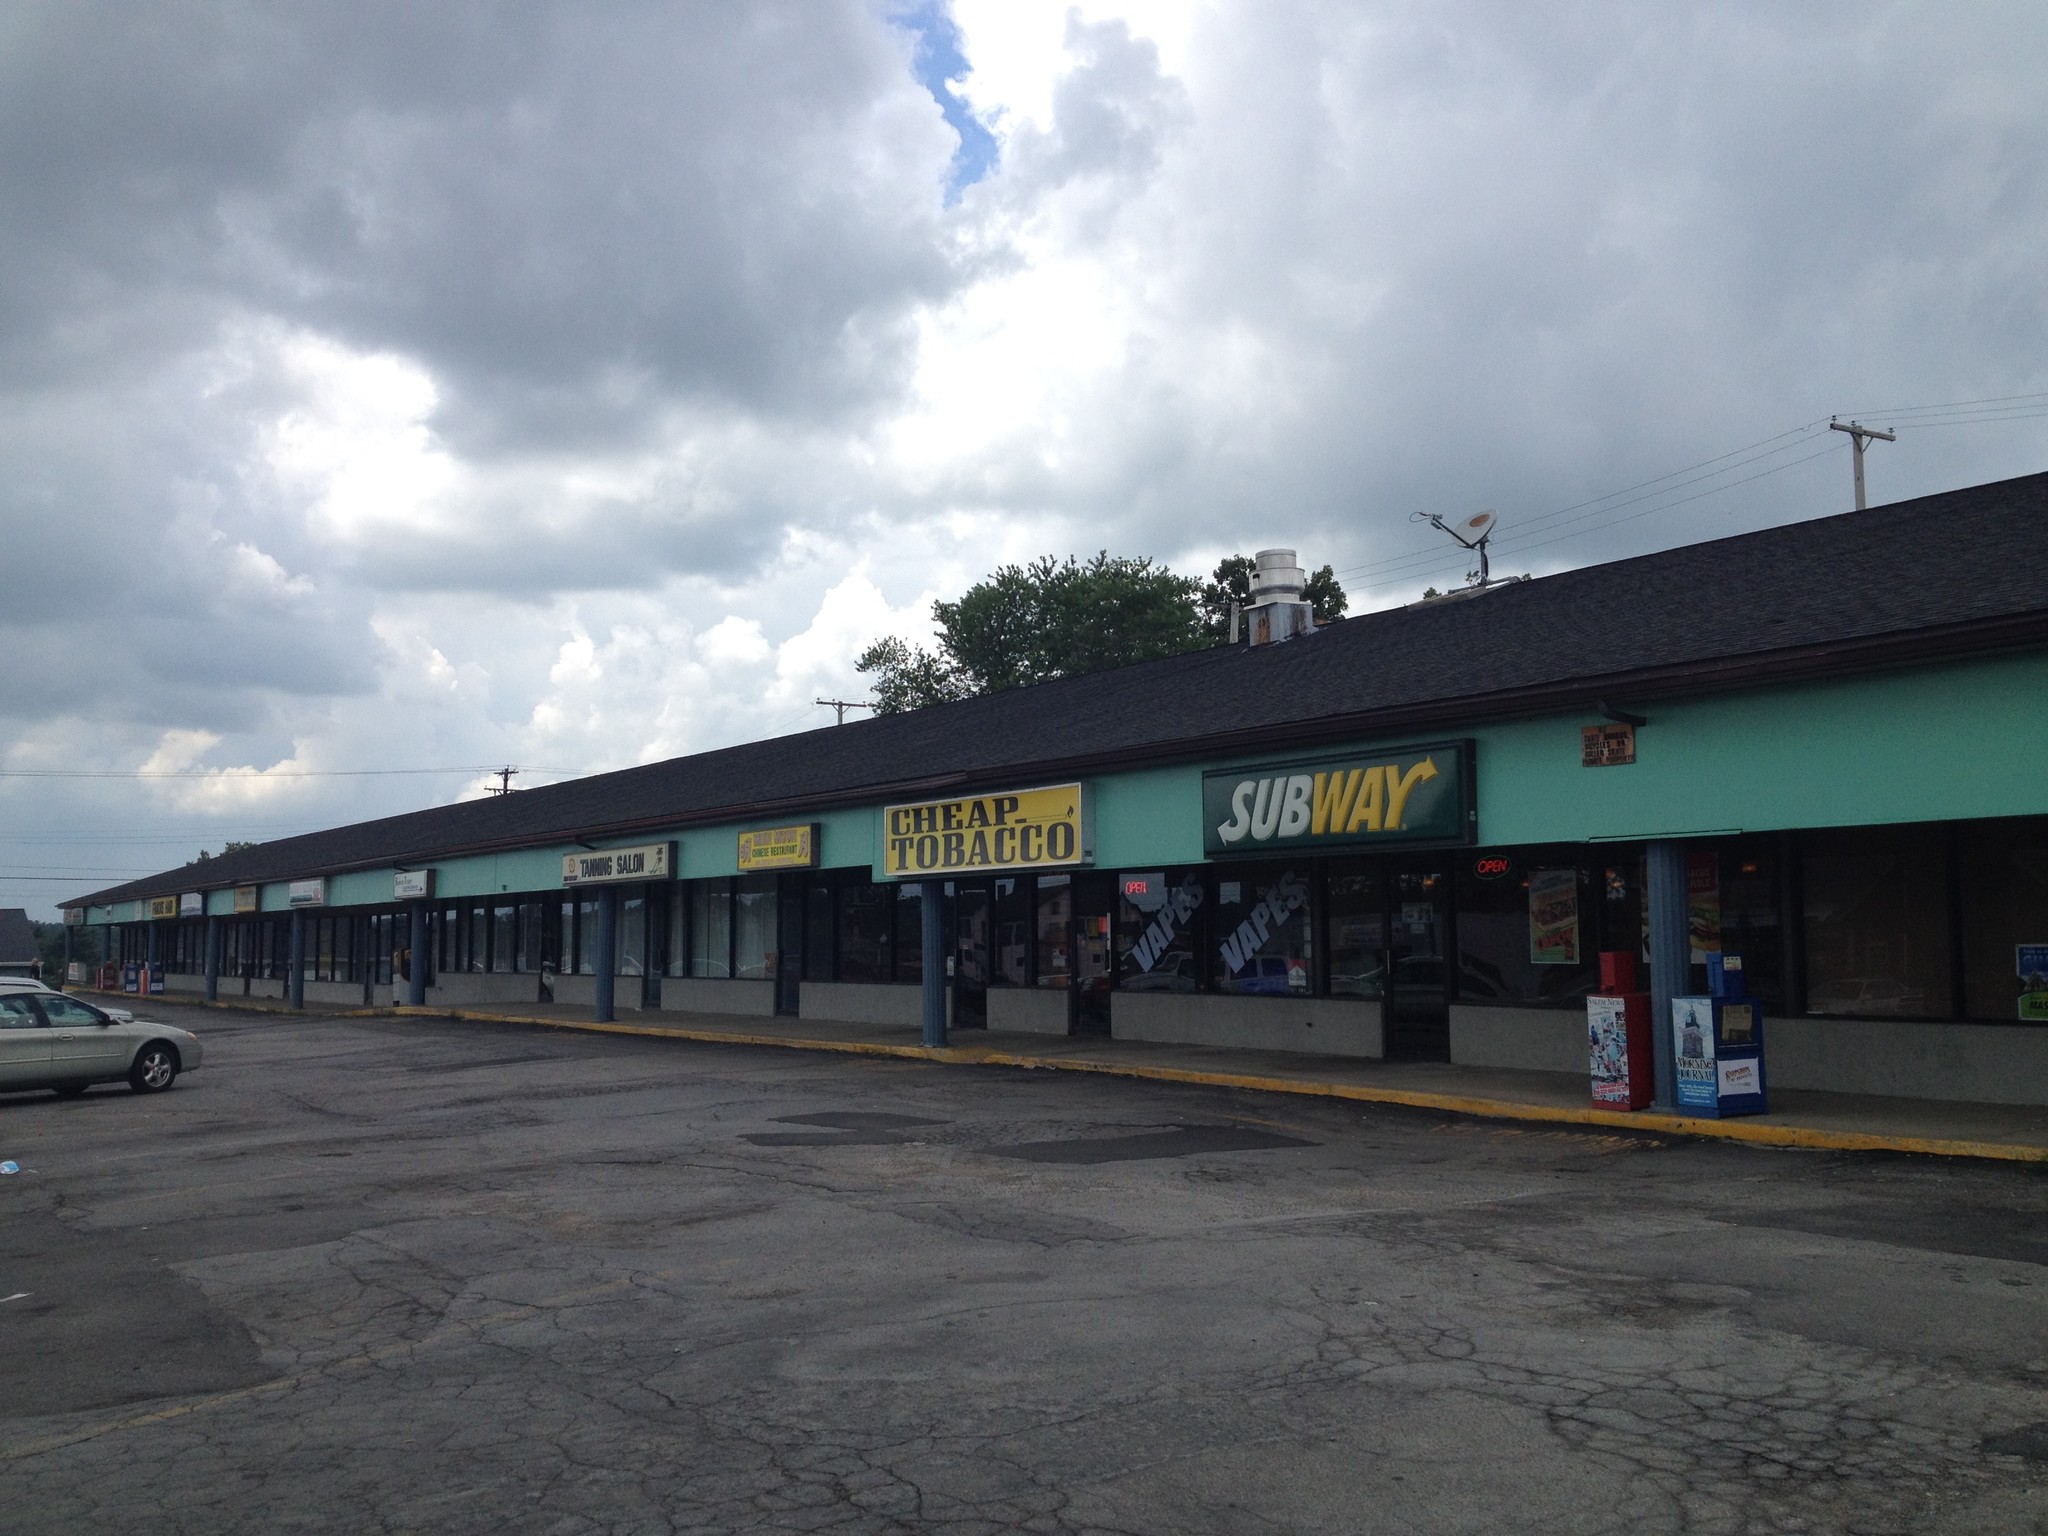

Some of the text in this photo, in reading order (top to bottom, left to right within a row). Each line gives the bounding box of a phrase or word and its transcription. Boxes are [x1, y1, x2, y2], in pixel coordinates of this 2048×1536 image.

[1217, 755, 1438, 847] SUBWAY
[891, 796, 1019, 836] CHEAP
[771, 844, 798, 857] RESTAURANT
[891, 821, 1075, 871] TOBACCO
[579, 853, 645, 878] TANNING SALON
[1477, 859, 1508, 874] OPEN
[1125, 880, 1147, 895] OPEN
[1133, 872, 1204, 974] VAPES
[1219, 871, 1308, 974] VAPES
[1677, 1057, 1714, 1069] MORNING
[1679, 1068, 1713, 1081] JOURNAL
